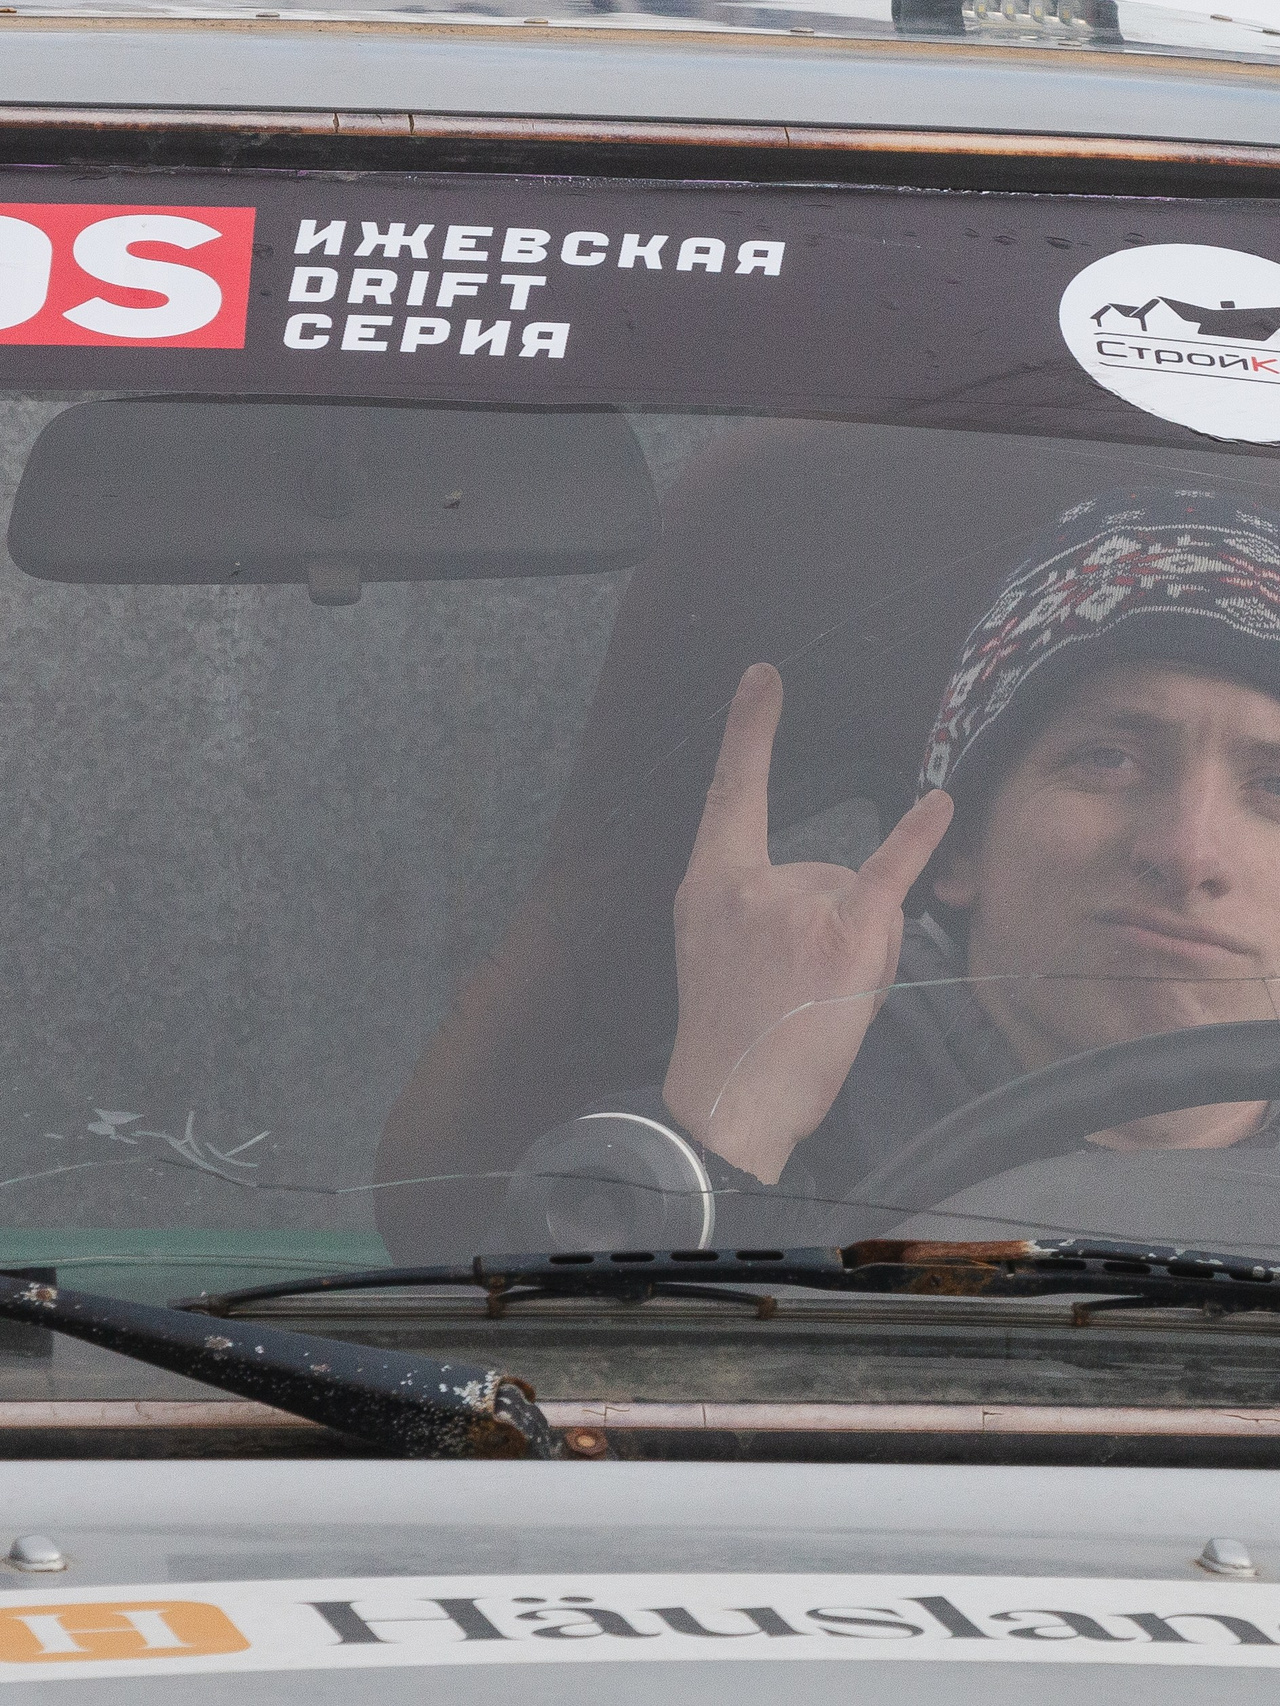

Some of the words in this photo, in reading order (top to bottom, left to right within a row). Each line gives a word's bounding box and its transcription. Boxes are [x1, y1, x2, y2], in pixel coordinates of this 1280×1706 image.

[293, 219, 786, 276] ИЖЕВСКАЯ
[287, 266, 547, 311] DRIFT
[282, 313, 571, 359] СЕРИЯ
[7, 1609, 197, 1655] H
